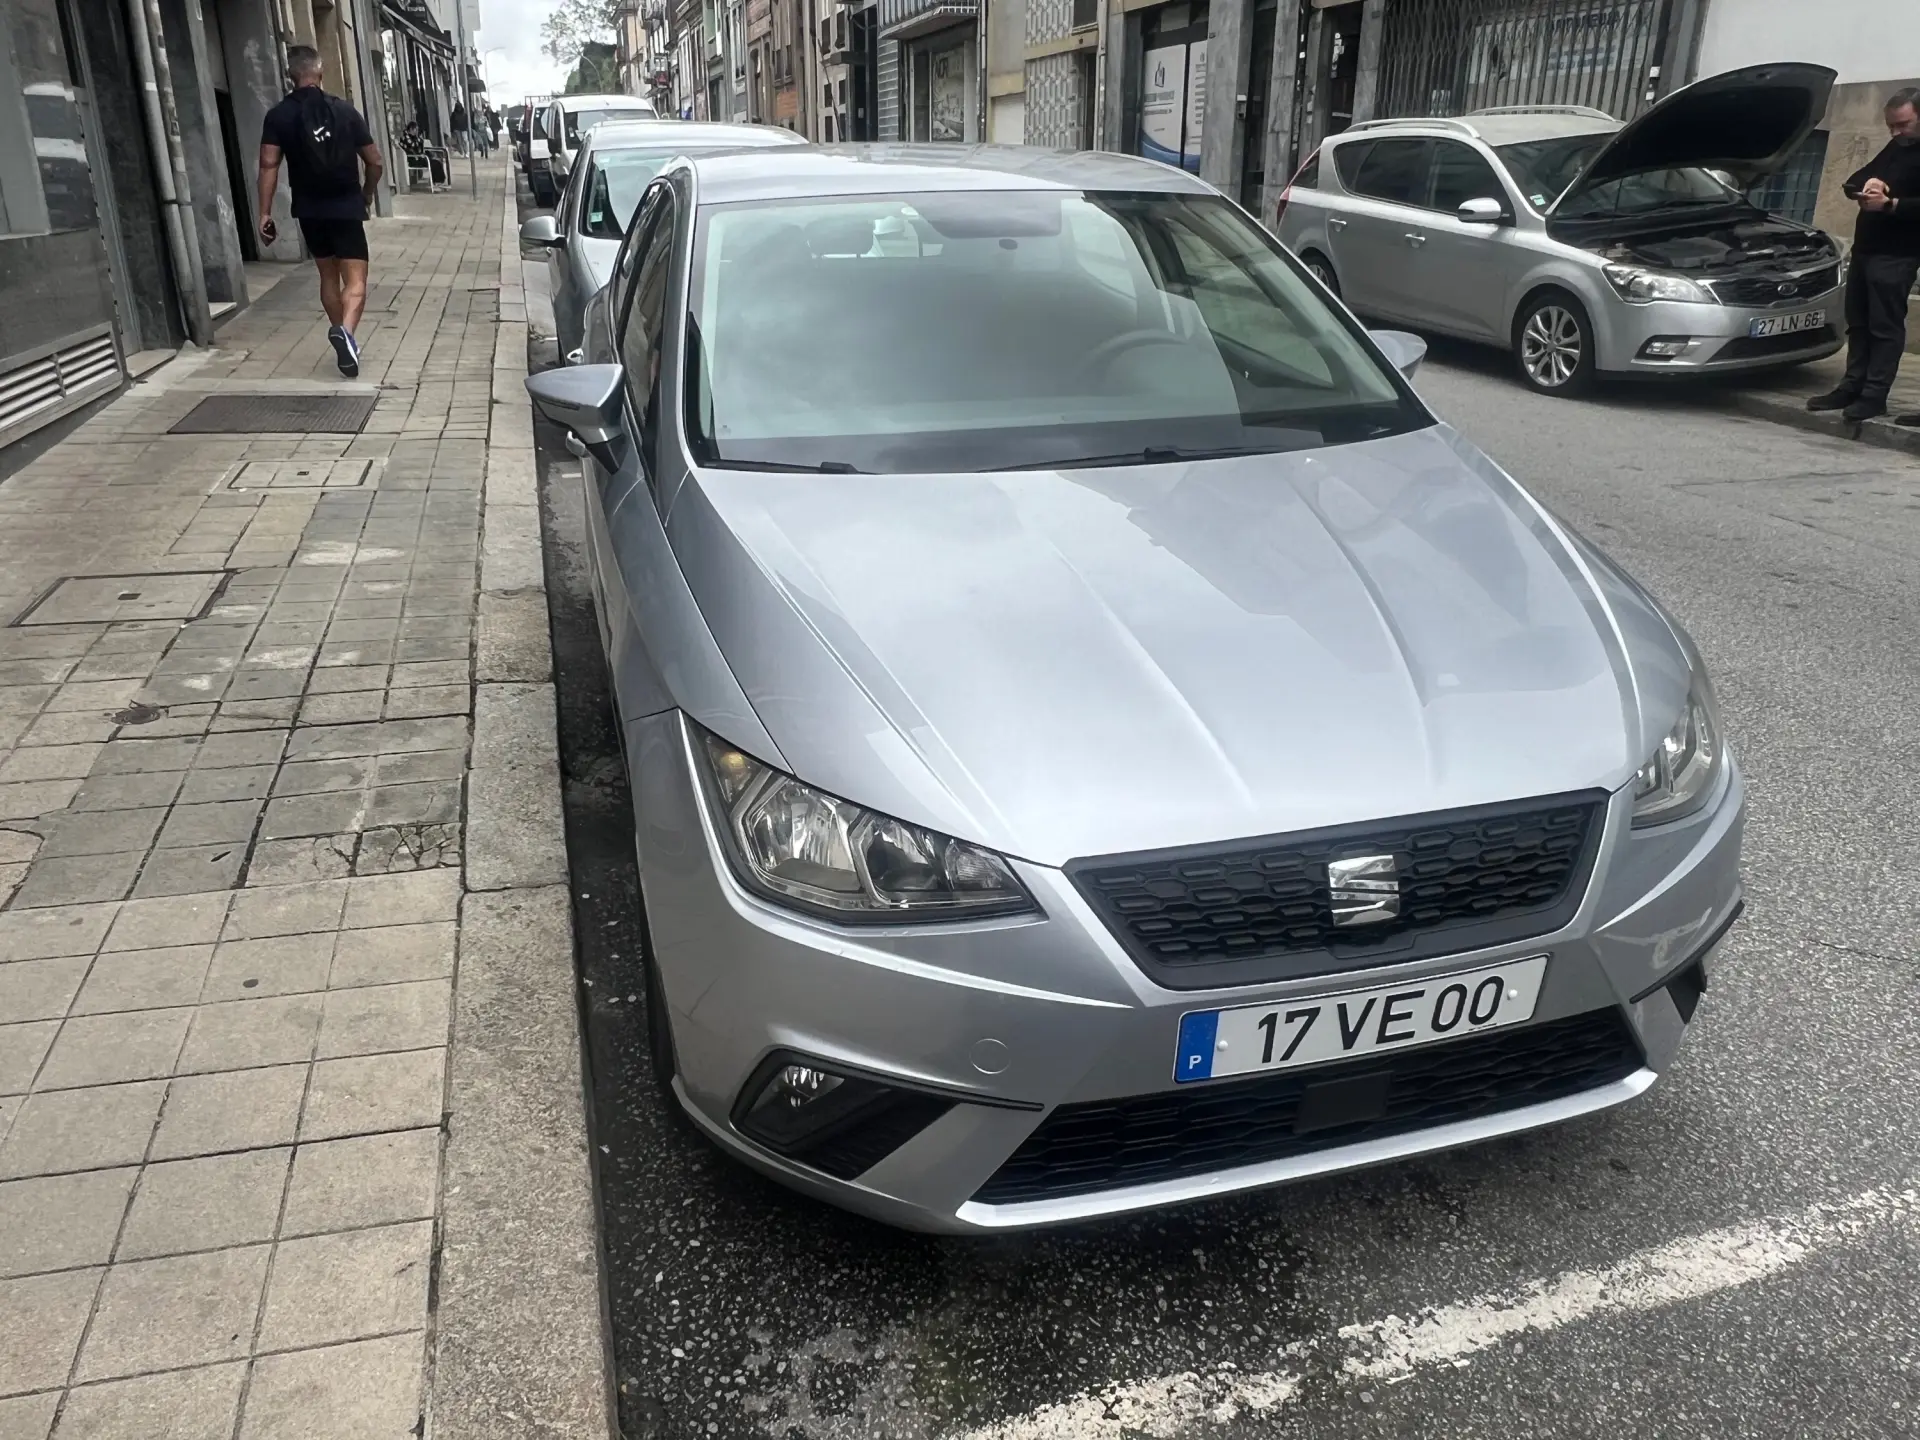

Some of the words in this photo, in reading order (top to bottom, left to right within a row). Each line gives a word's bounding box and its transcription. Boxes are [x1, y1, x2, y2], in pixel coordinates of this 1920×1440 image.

[1257, 1006, 1321, 1065] 17
[1336, 989, 1425, 1051] VE
[1431, 975, 1505, 1034] 00
[1188, 1054, 1202, 1071] P
